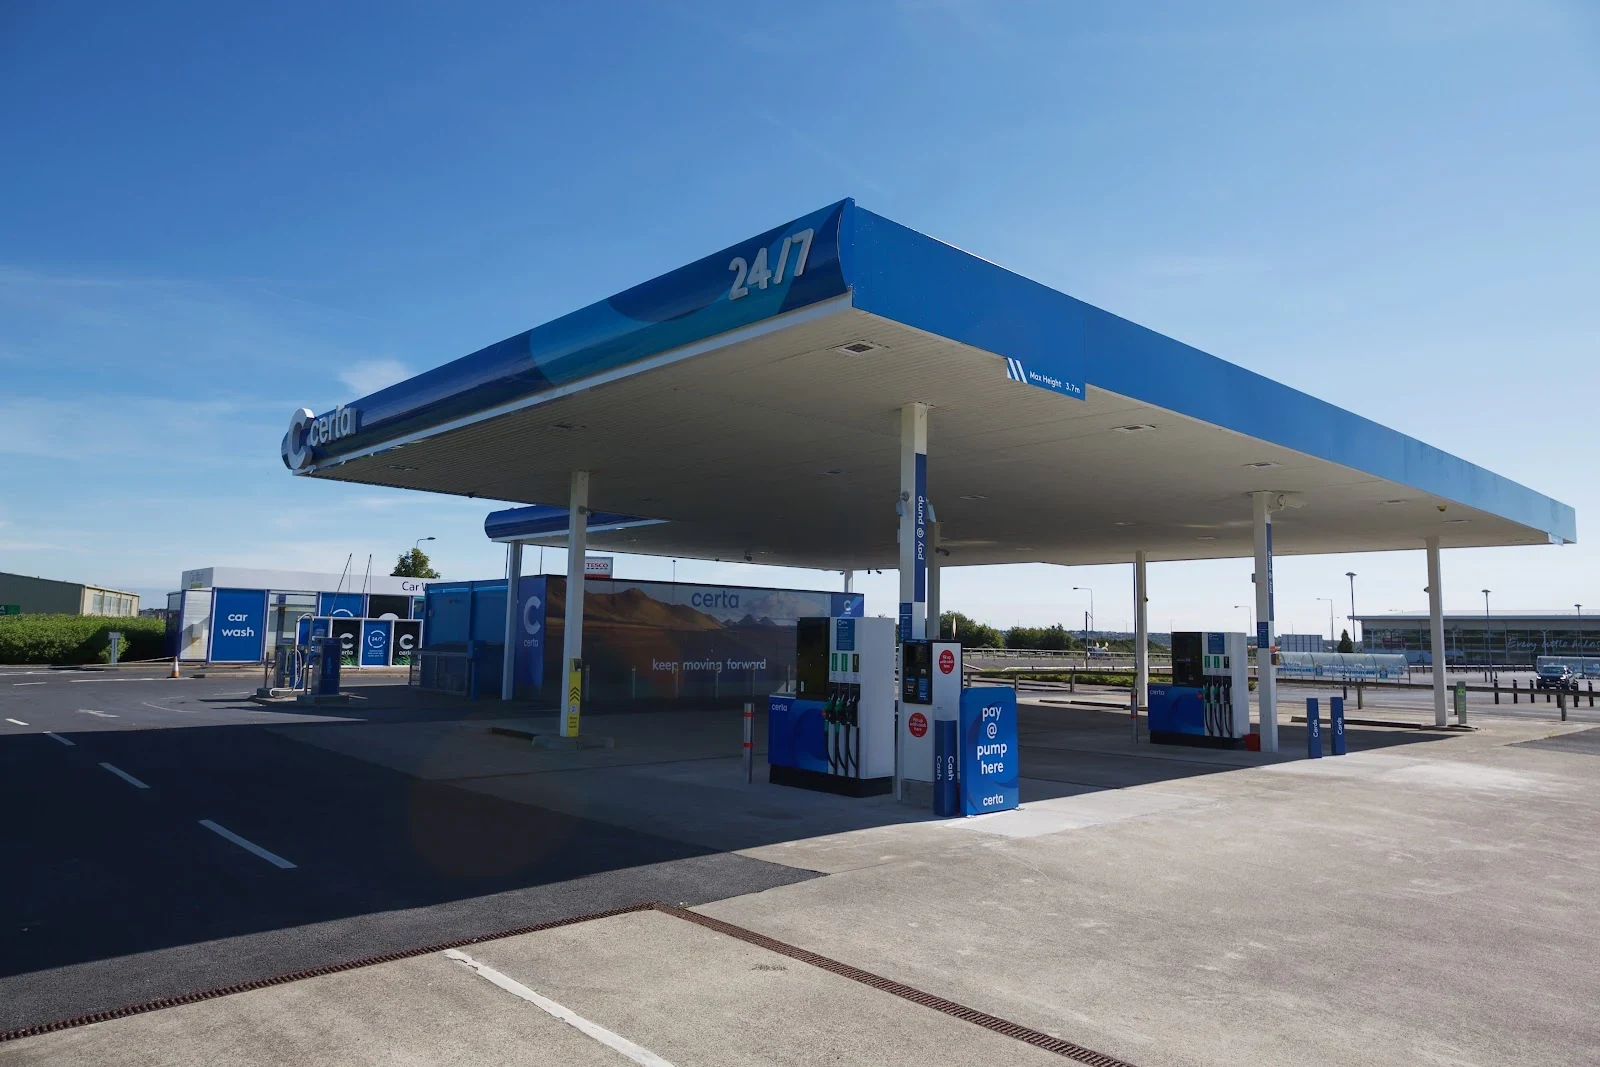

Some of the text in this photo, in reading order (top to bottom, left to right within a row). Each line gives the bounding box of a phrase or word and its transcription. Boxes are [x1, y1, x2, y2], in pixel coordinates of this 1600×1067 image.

[728, 228, 814, 300] 24/7
[1029, 371, 1042, 381] Max
[1043, 375, 1062, 388] Height
[308, 403, 357, 447] certa
[917, 528, 924, 538] @
[401, 581, 420, 592] Car
[691, 590, 741, 609] certa
[227, 613, 249, 622] car
[221, 627, 255, 637] wash
[523, 638, 539, 648] certa
[652, 658, 767, 675] keep moving forward
[771, 703, 788, 712] certa
[982, 707, 1002, 722] pay
[986, 722, 998, 739] @
[976, 743, 1008, 760] pump
[947, 755, 955, 781] Cash
[981, 760, 1004, 775] here
[983, 793, 1004, 806] certa
